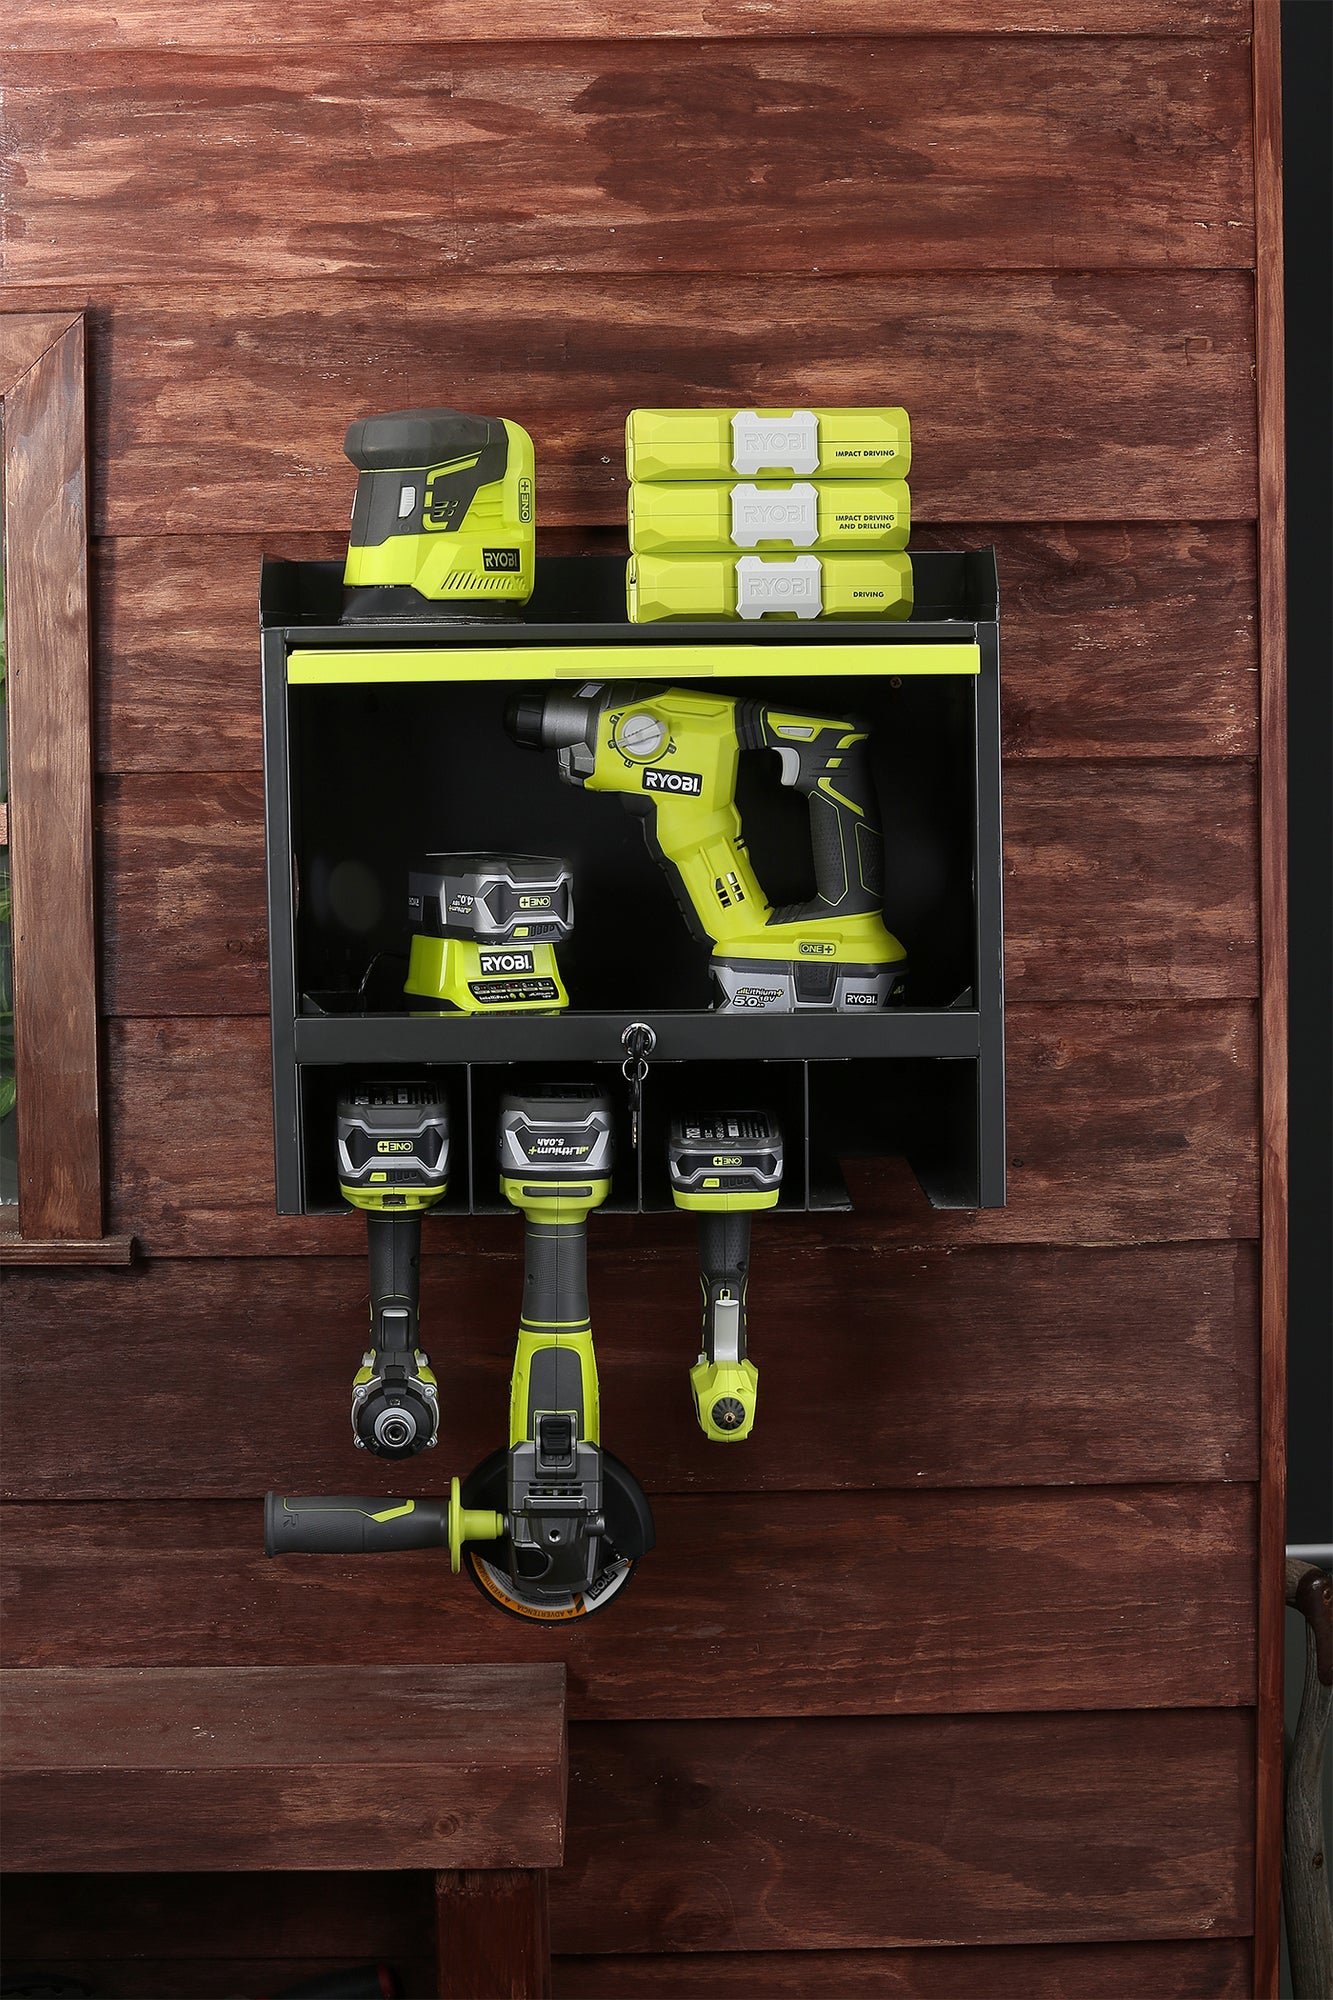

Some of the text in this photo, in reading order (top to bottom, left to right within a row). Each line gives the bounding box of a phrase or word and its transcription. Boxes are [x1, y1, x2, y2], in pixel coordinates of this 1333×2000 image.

[744, 432, 808, 451] RYOBI
[863, 449, 895, 457] DRIVING
[743, 505, 806, 524] RYOBI
[484, 552, 518, 567] RYOBI
[748, 577, 811, 597] RYOBI
[537, 1138, 565, 1147] 5.0Ah
